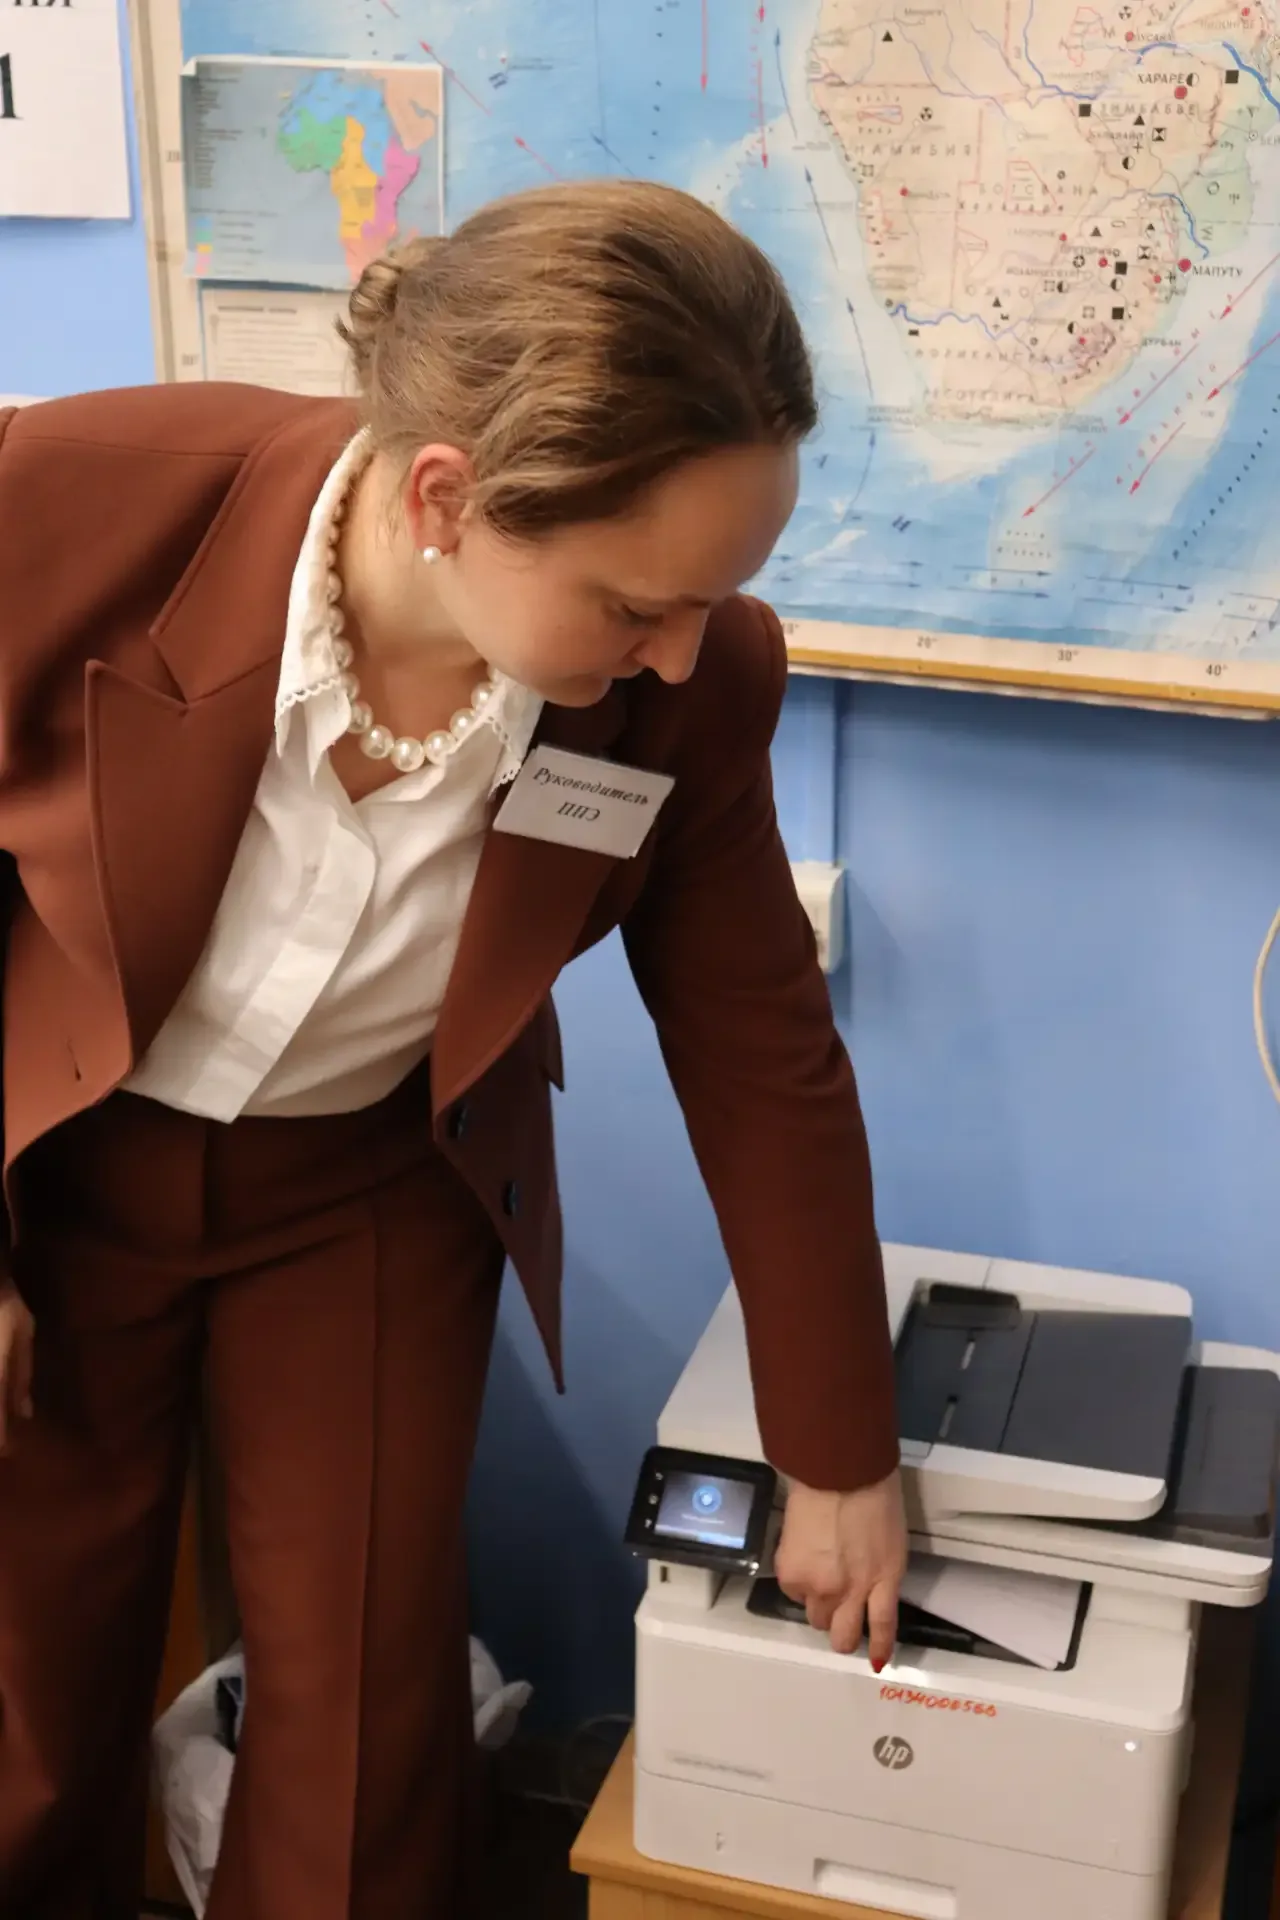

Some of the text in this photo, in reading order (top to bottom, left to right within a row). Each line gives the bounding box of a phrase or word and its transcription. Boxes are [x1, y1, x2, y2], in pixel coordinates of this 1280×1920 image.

[1137, 73, 1184, 84] ХАРАРЕ
[1192, 265, 1243, 278] МАПУТУ
[1058, 649, 1079, 662] 30°
[1206, 664, 1228, 677] 40°
[533, 767, 649, 806] Руководитель
[557, 801, 601, 822] ППЭ
[879, 1736, 910, 1768] hp
